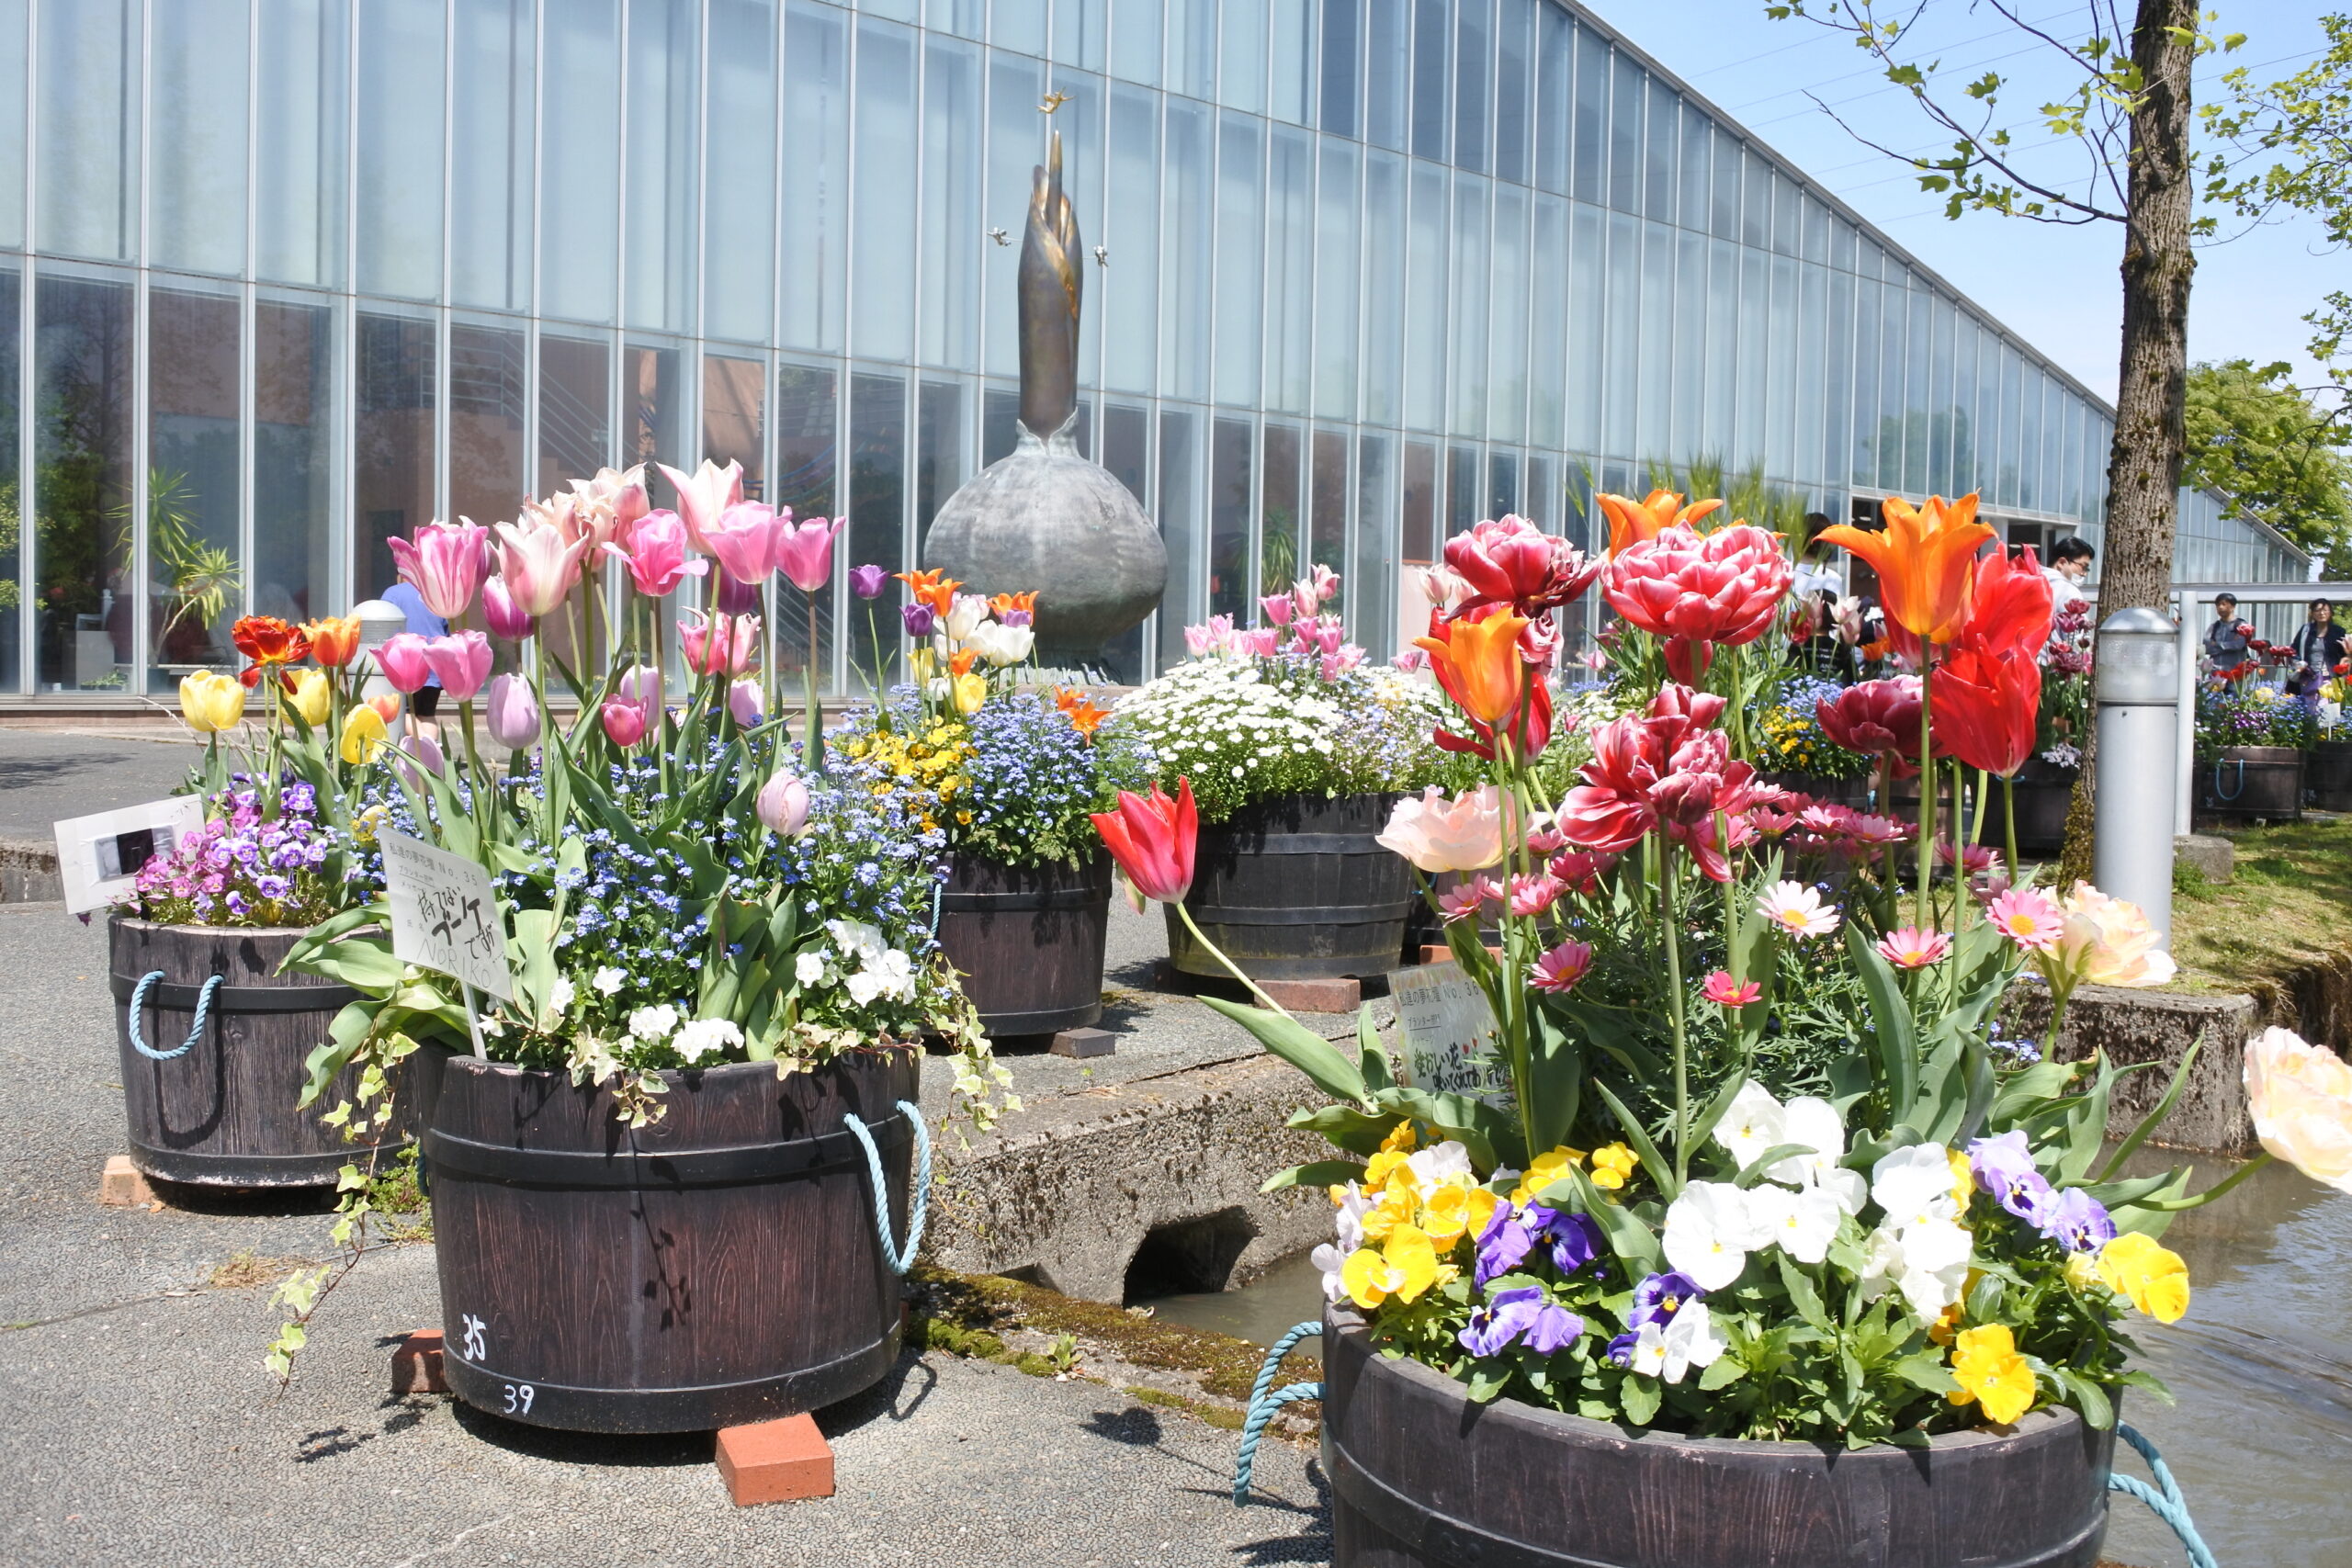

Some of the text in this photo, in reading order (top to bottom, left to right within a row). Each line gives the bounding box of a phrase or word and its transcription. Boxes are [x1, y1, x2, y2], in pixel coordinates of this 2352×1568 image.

[416, 937, 492, 988] NORIKO
[1464, 981, 1479, 997] 36
[462, 1313, 487, 1361] 35
[503, 1384, 535, 1417] 39
